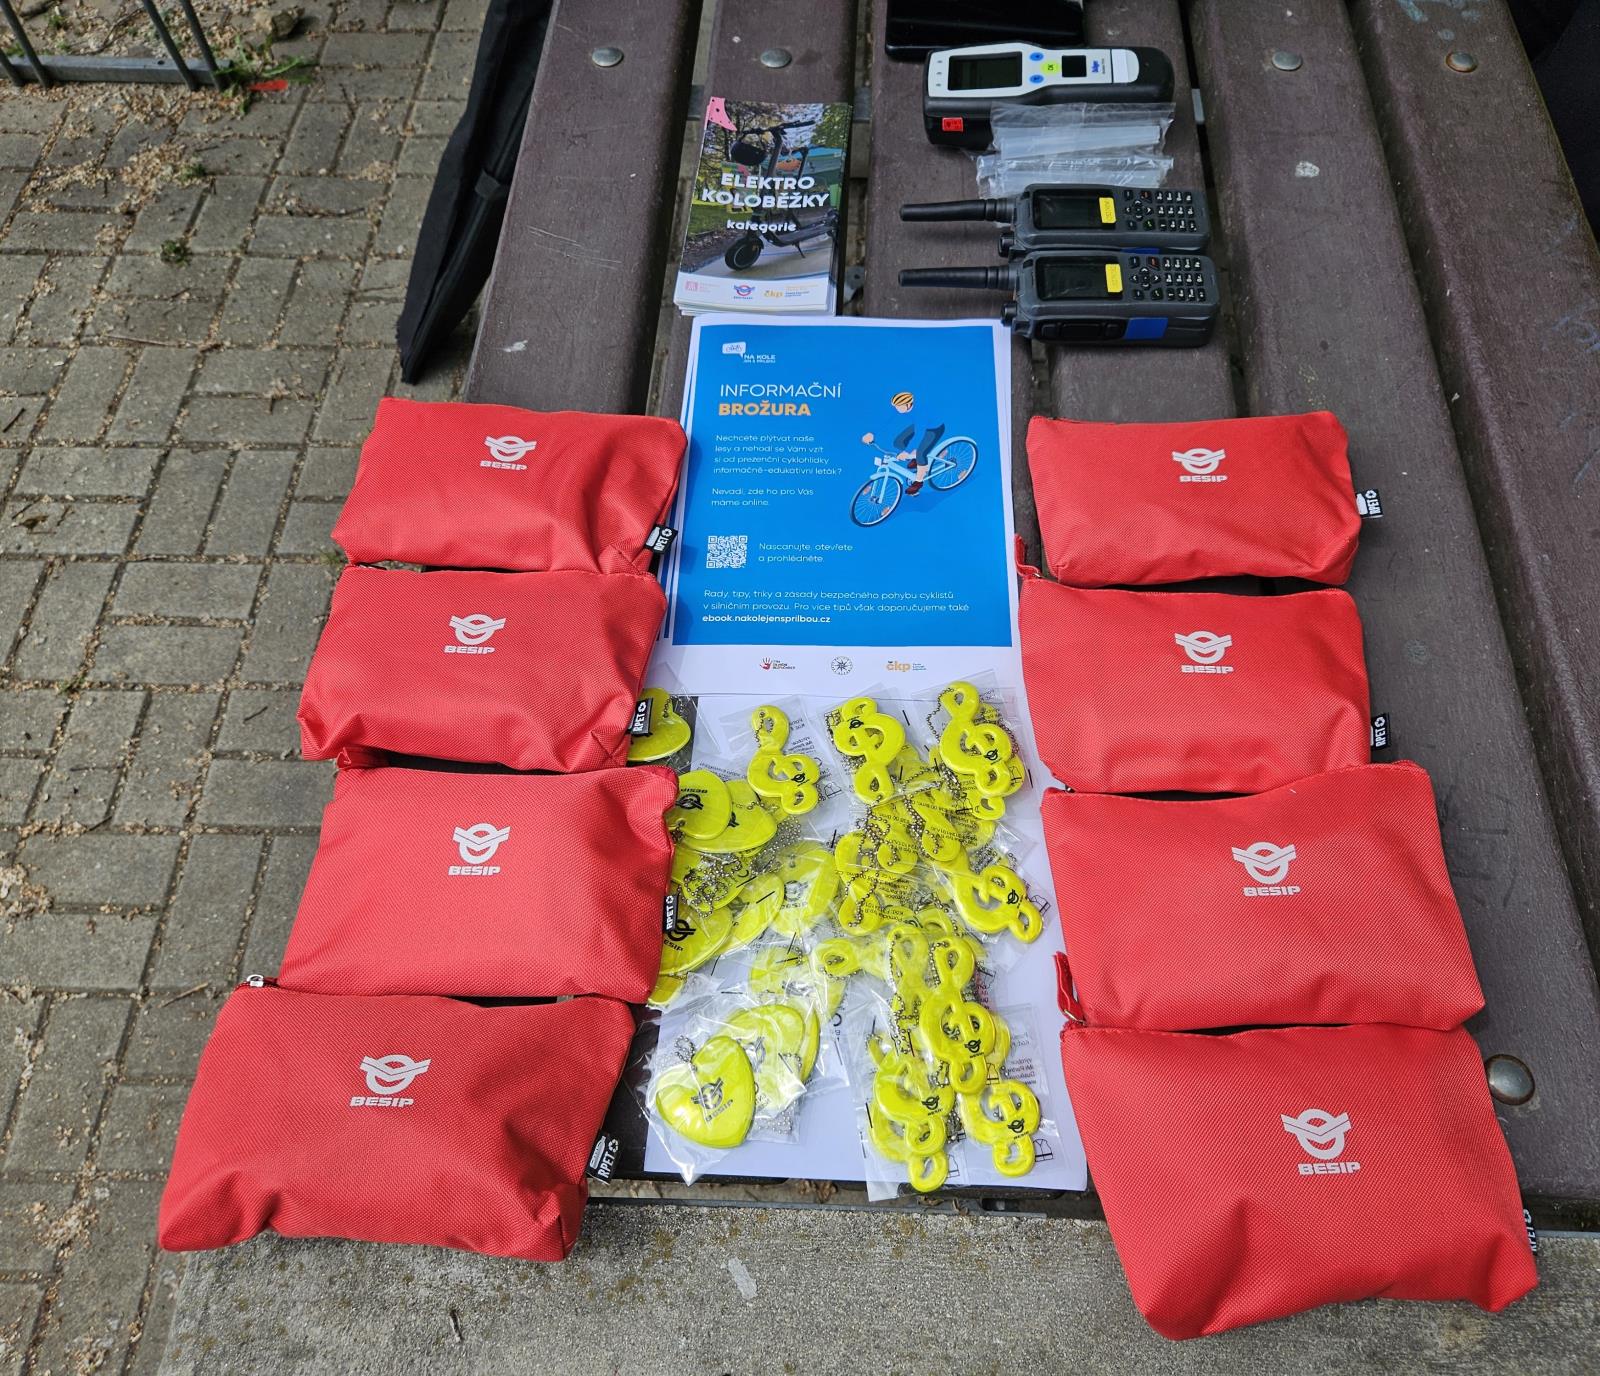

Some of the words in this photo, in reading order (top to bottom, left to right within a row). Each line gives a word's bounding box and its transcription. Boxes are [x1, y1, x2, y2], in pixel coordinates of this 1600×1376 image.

[720, 173, 815, 191] ELEKTRO
[701, 188, 830, 209] KOLOBĚŽKY
[726, 219, 797, 233] kategorie
[720, 381, 842, 398] INFORMAČNÍ
[718, 399, 812, 416] BROŽURA
[716, 434, 759, 442] Nechcete
[715, 445, 732, 454] lesy
[480, 460, 527, 471] BESIP
[1179, 474, 1228, 483] BESIP
[780, 489, 796, 497] pro
[732, 590, 751, 599] tipy,
[754, 590, 773, 599] triky
[784, 590, 818, 599] zásady
[820, 590, 879, 600] bezpečného
[881, 591, 917, 600] pohybu
[919, 591, 954, 600] cyklistů
[794, 602, 810, 610] Pro
[833, 602, 852, 612] tipů
[854, 603, 875, 611] však
[877, 603, 947, 613] doporučujeme
[948, 603, 970, 612] také
[702, 614, 831, 624] ebook.nakolejensprilbou.cz
[444, 644, 495, 654] BESIP
[1181, 664, 1234, 674] BESIP
[632, 713, 645, 732] RPET
[448, 866, 501, 876] BESIP
[1243, 886, 1301, 897] BESIP
[666, 905, 674, 930] RPET
[350, 1096, 414, 1108] BESIP
[597, 1150, 615, 1179] RPET
[1298, 1161, 1361, 1175] BESIP
